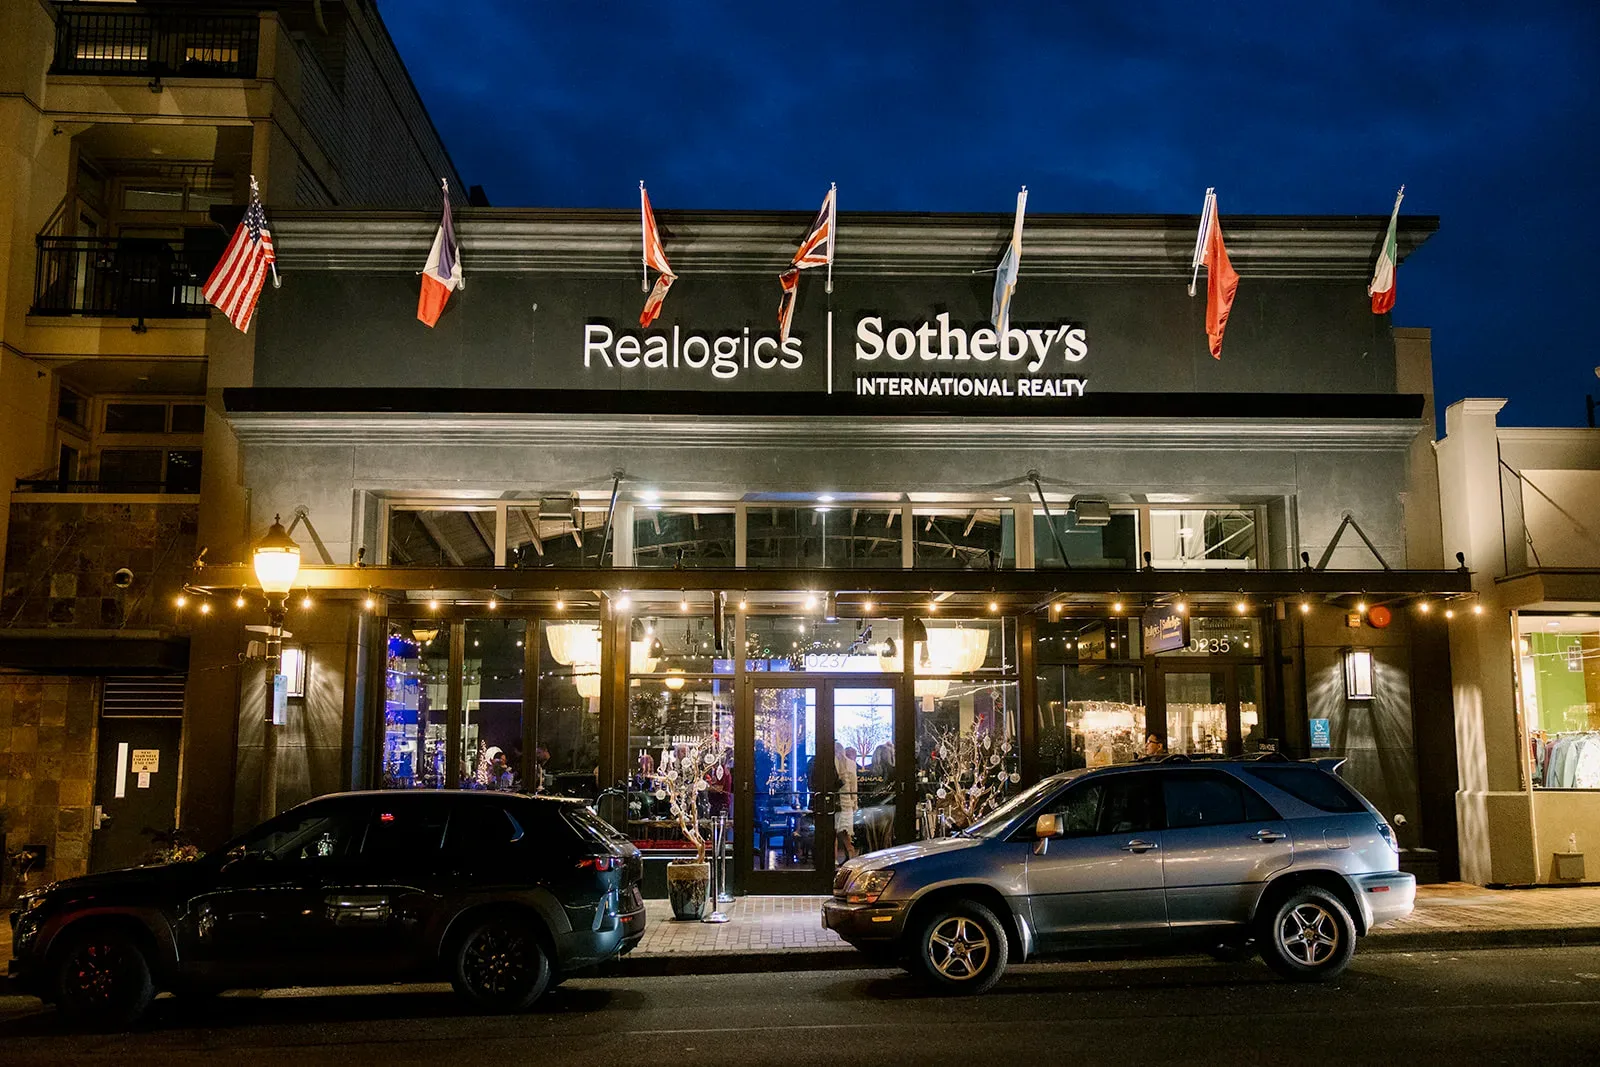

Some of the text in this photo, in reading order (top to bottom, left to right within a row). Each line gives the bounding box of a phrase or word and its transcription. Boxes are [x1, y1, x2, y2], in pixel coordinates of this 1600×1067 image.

[584, 324, 804, 379] Realogics
[855, 312, 1088, 373] Sotheby's
[856, 377, 1088, 397] INTERNATIONAL REALTY
[799, 653, 848, 668] 10237
